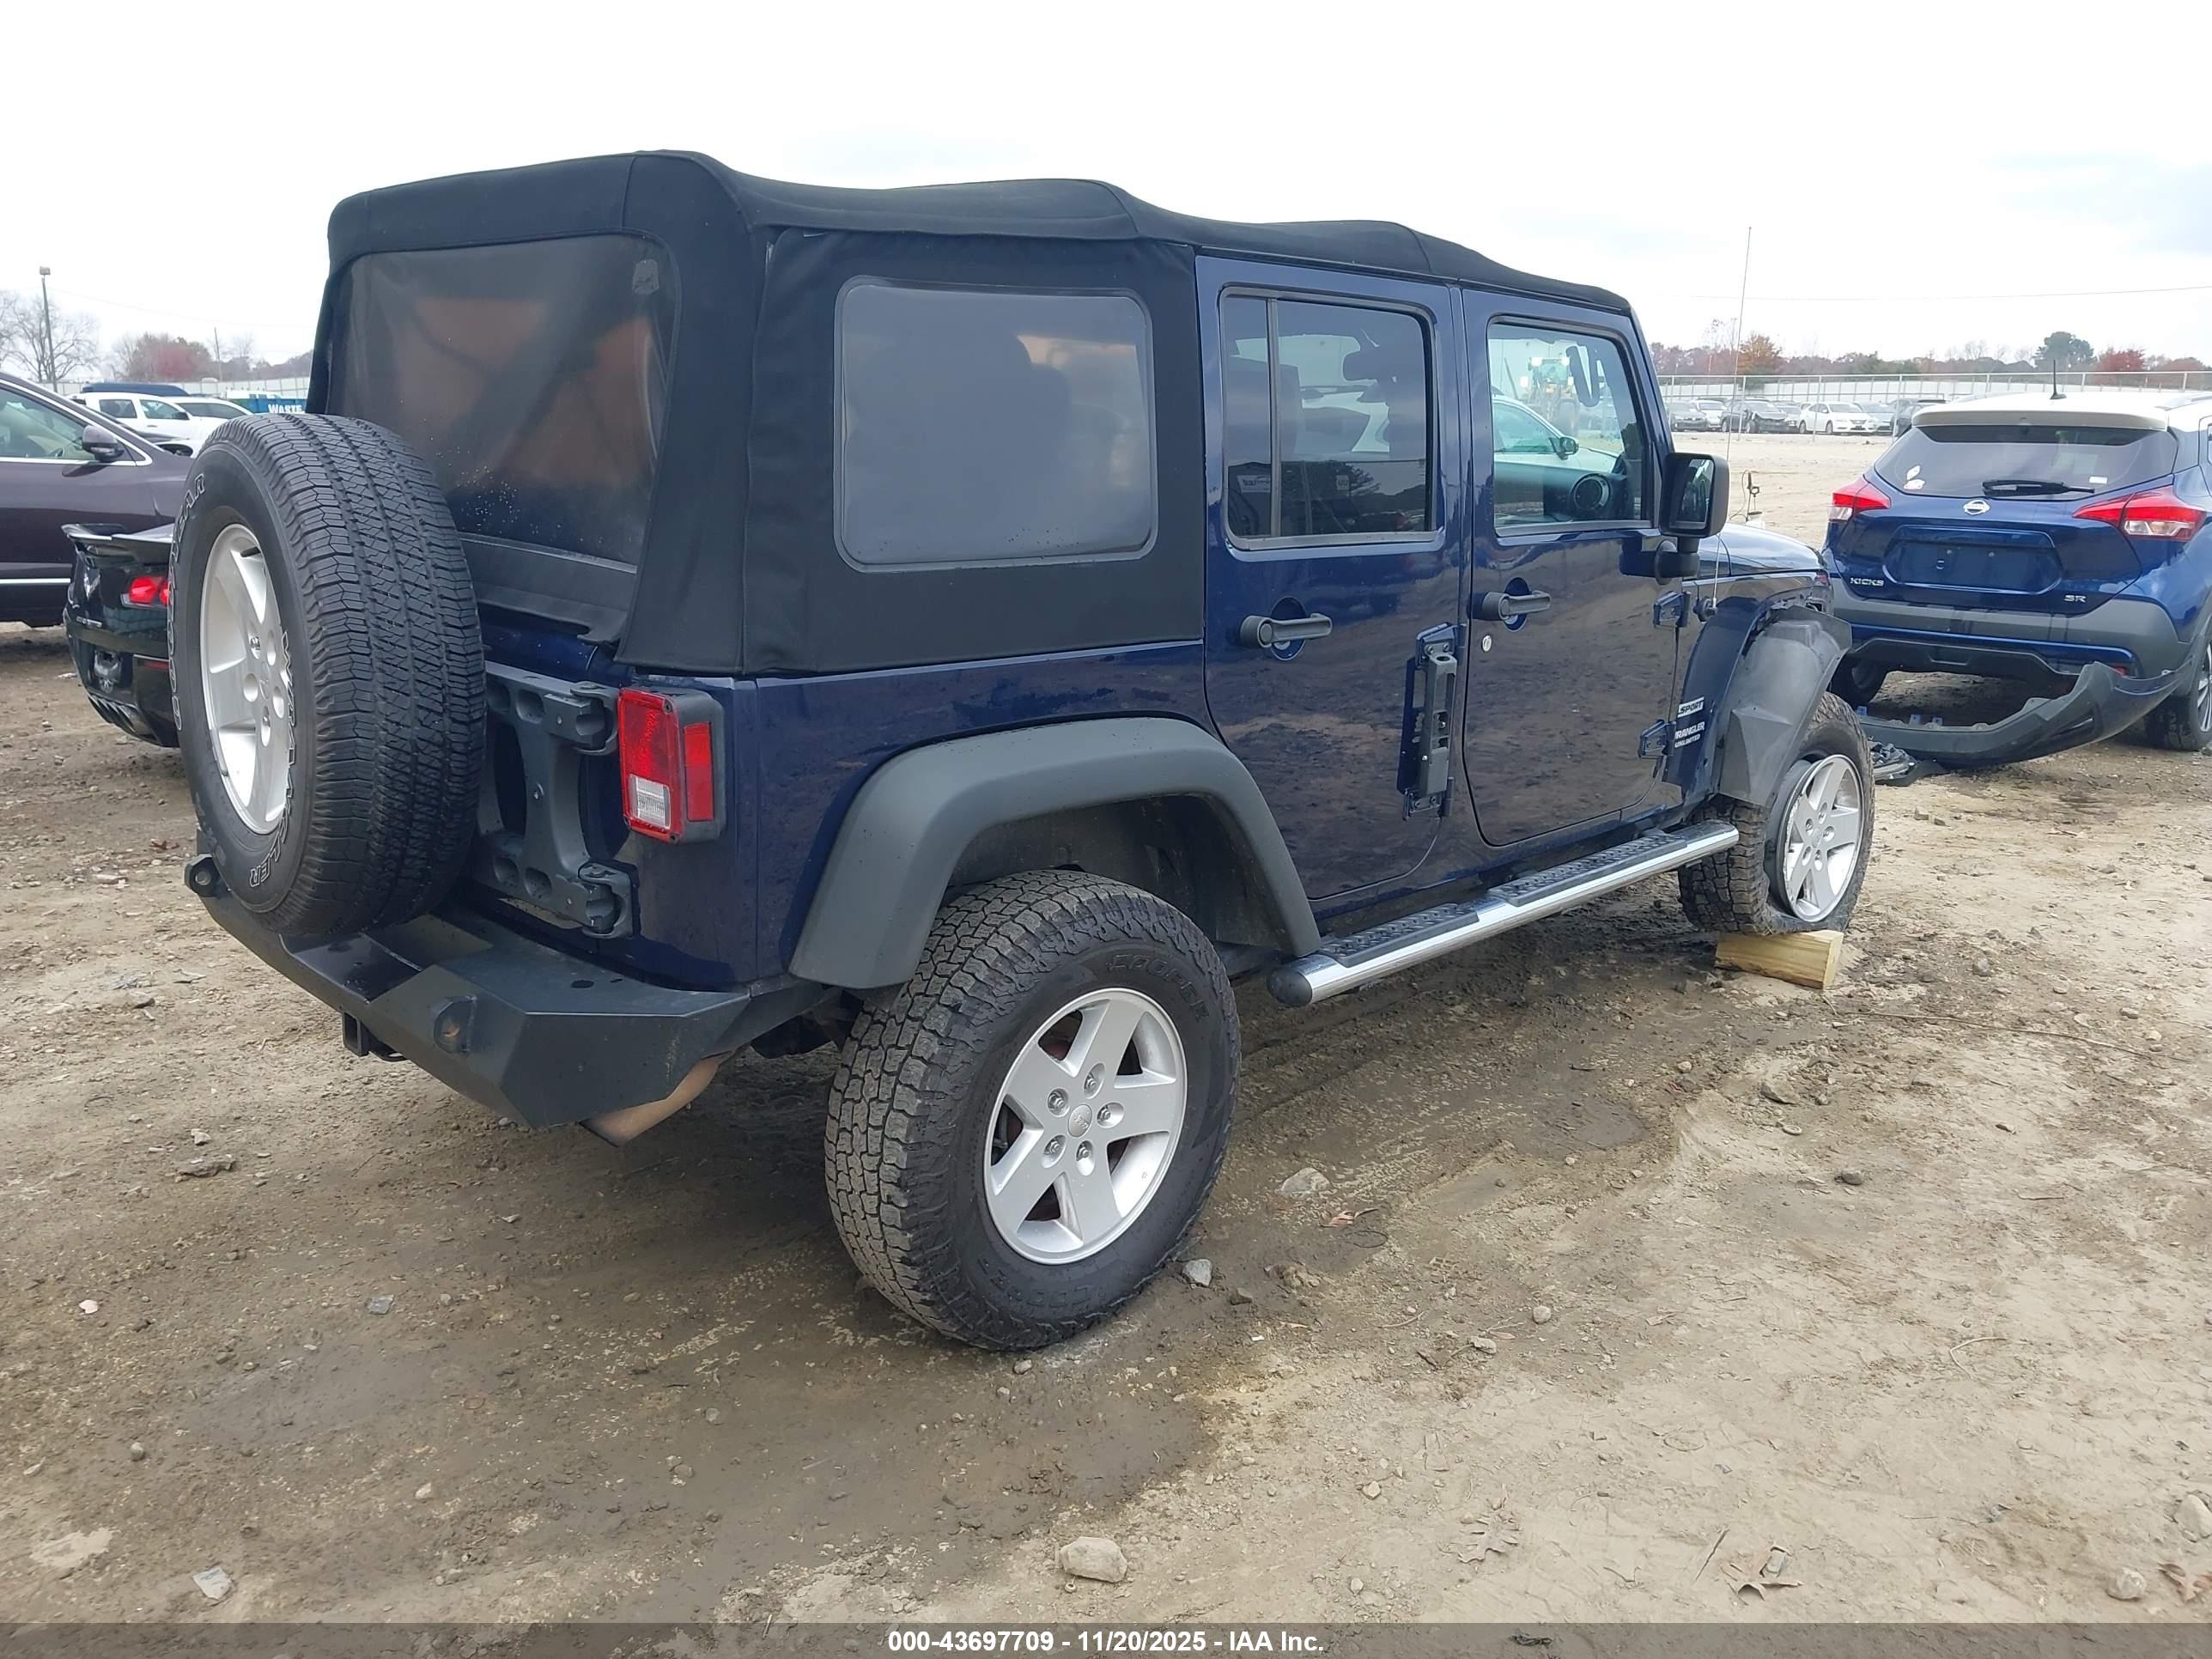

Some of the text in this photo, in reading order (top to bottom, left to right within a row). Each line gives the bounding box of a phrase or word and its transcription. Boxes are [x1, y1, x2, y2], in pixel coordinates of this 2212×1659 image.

[1850, 577, 1884, 586] KICKS
[2063, 594, 2087, 603] SR
[1679, 700, 1704, 714] SPORT
